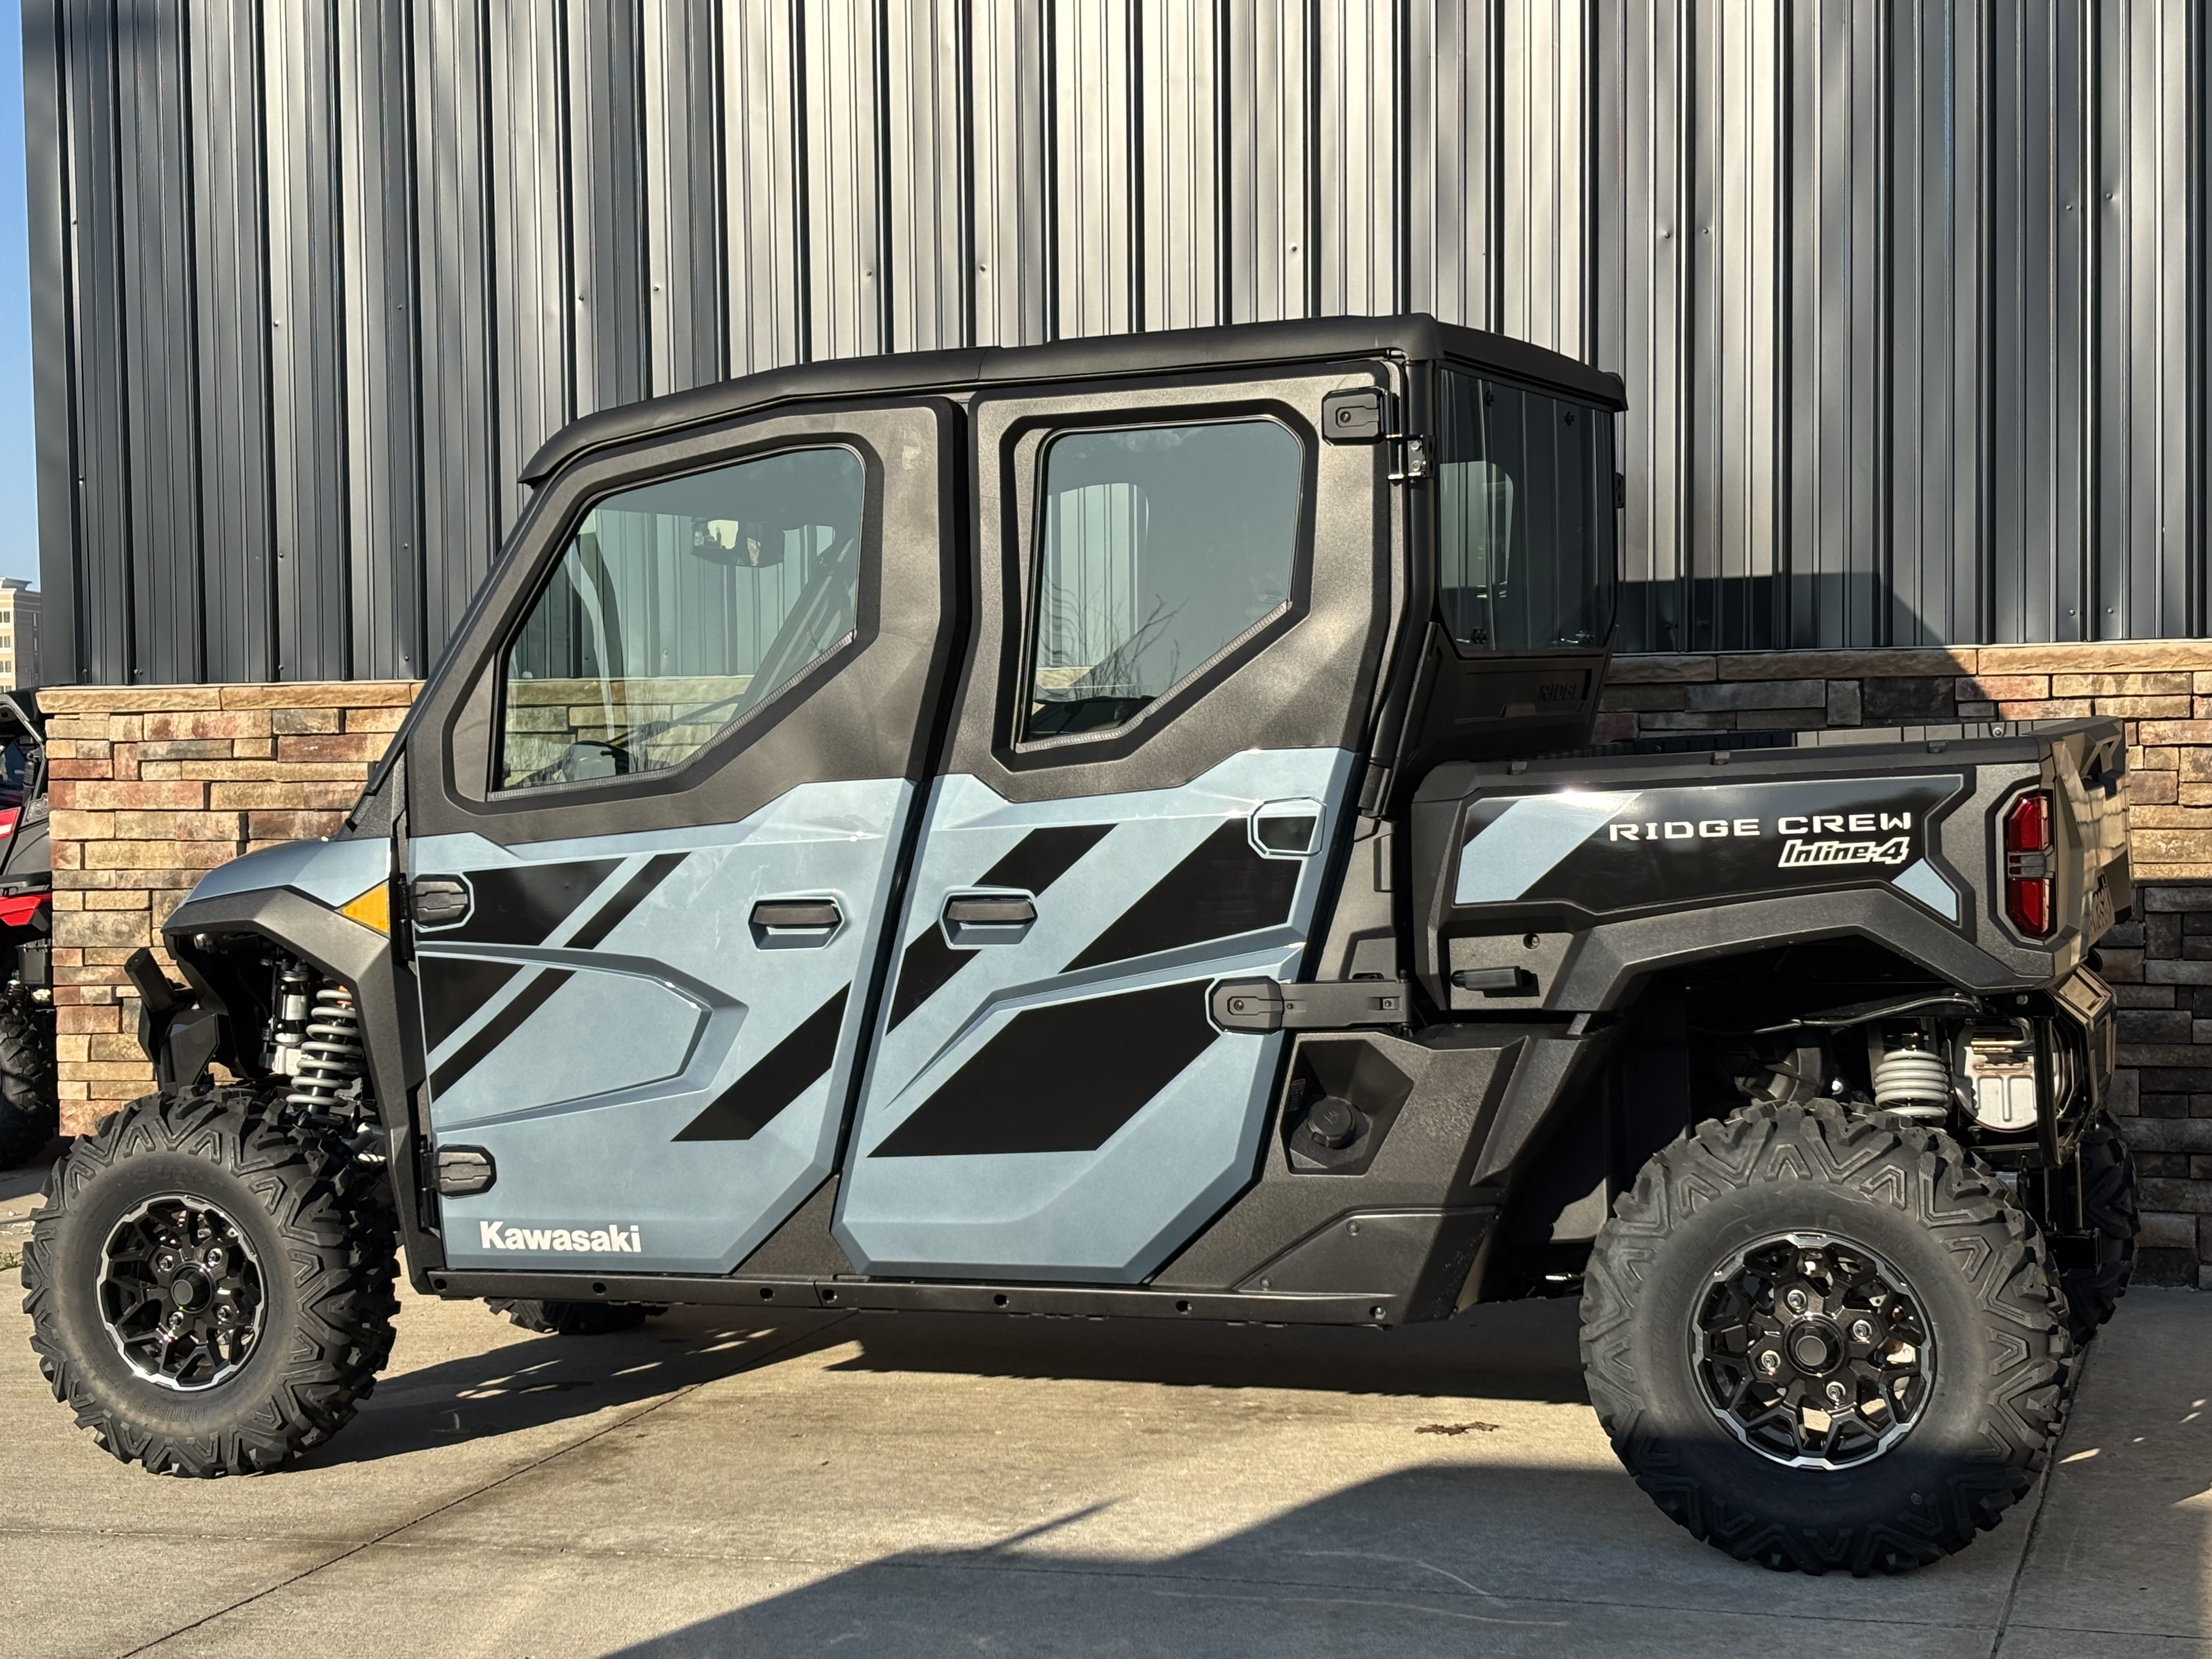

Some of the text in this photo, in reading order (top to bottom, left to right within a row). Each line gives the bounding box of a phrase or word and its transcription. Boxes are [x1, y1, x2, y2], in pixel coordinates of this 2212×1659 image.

[1609, 812, 1911, 842] RIDGE CREW
[1778, 836, 1911, 868] Inline-4
[479, 1221, 642, 1252] Kawasaki
